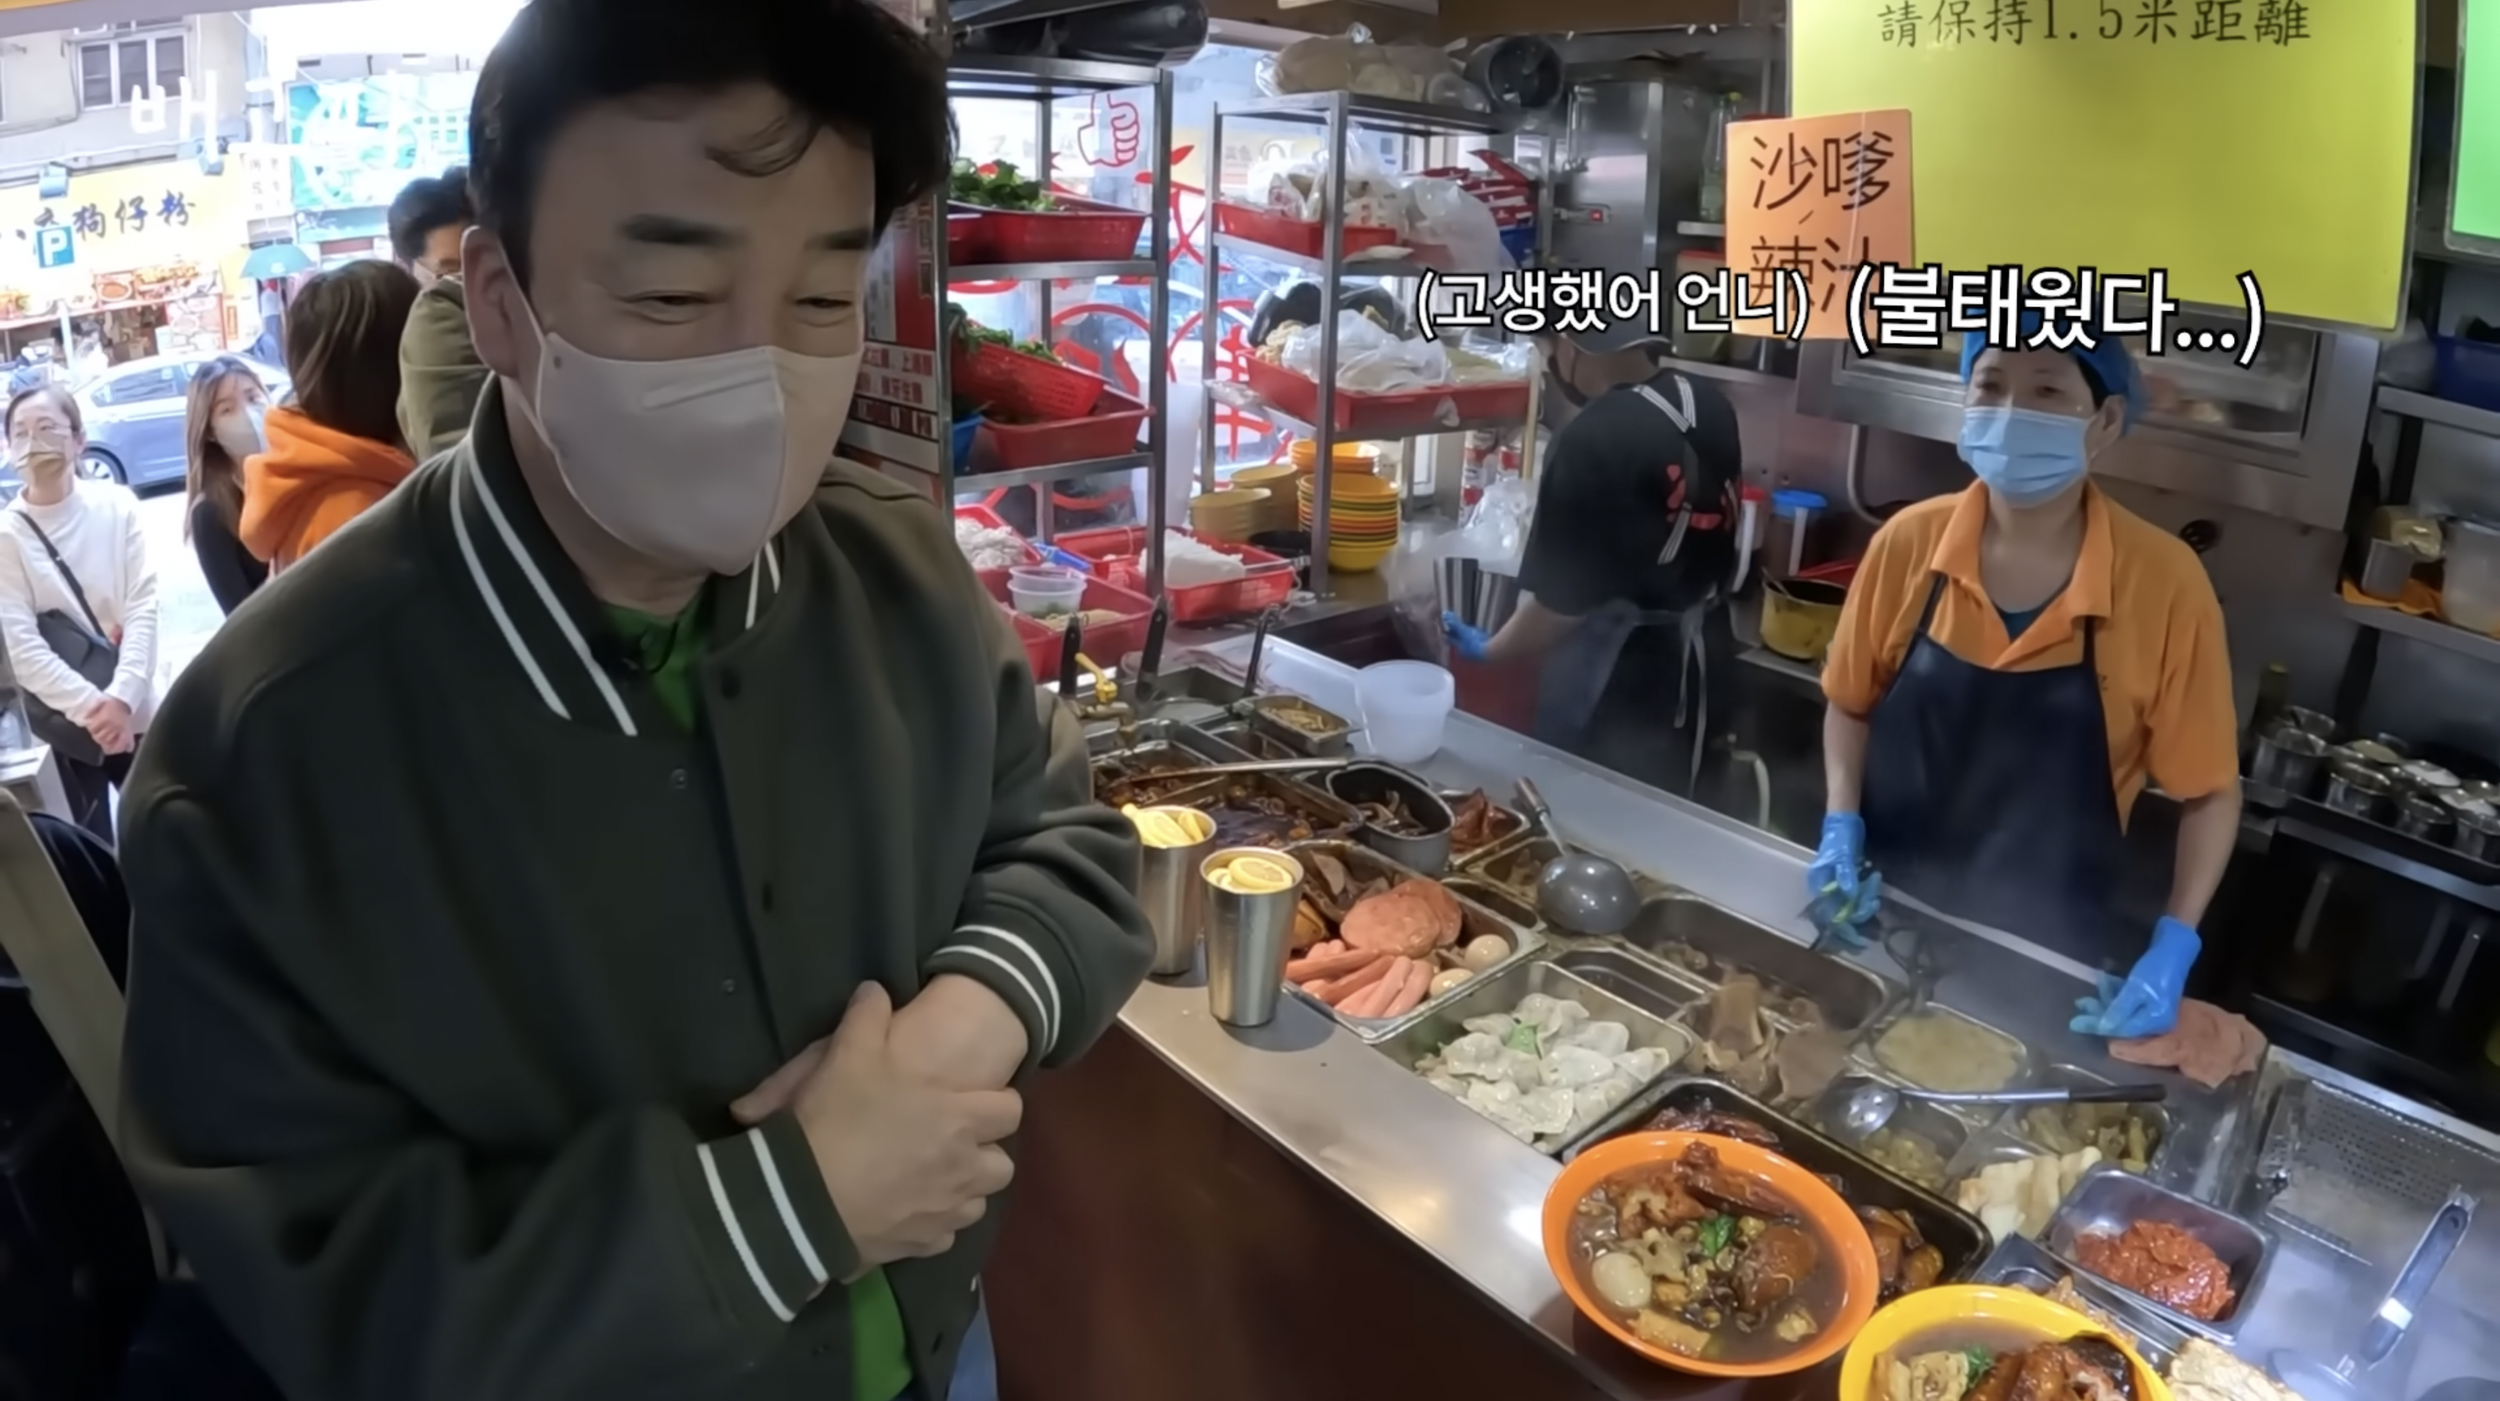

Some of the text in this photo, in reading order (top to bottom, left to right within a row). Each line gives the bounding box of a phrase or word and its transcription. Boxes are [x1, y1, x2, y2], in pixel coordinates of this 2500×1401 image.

[1878, 0, 2311, 48] 請保持1.5米距離
[1750, 131, 1894, 211] 沙嗲
[41, 229, 68, 266] P
